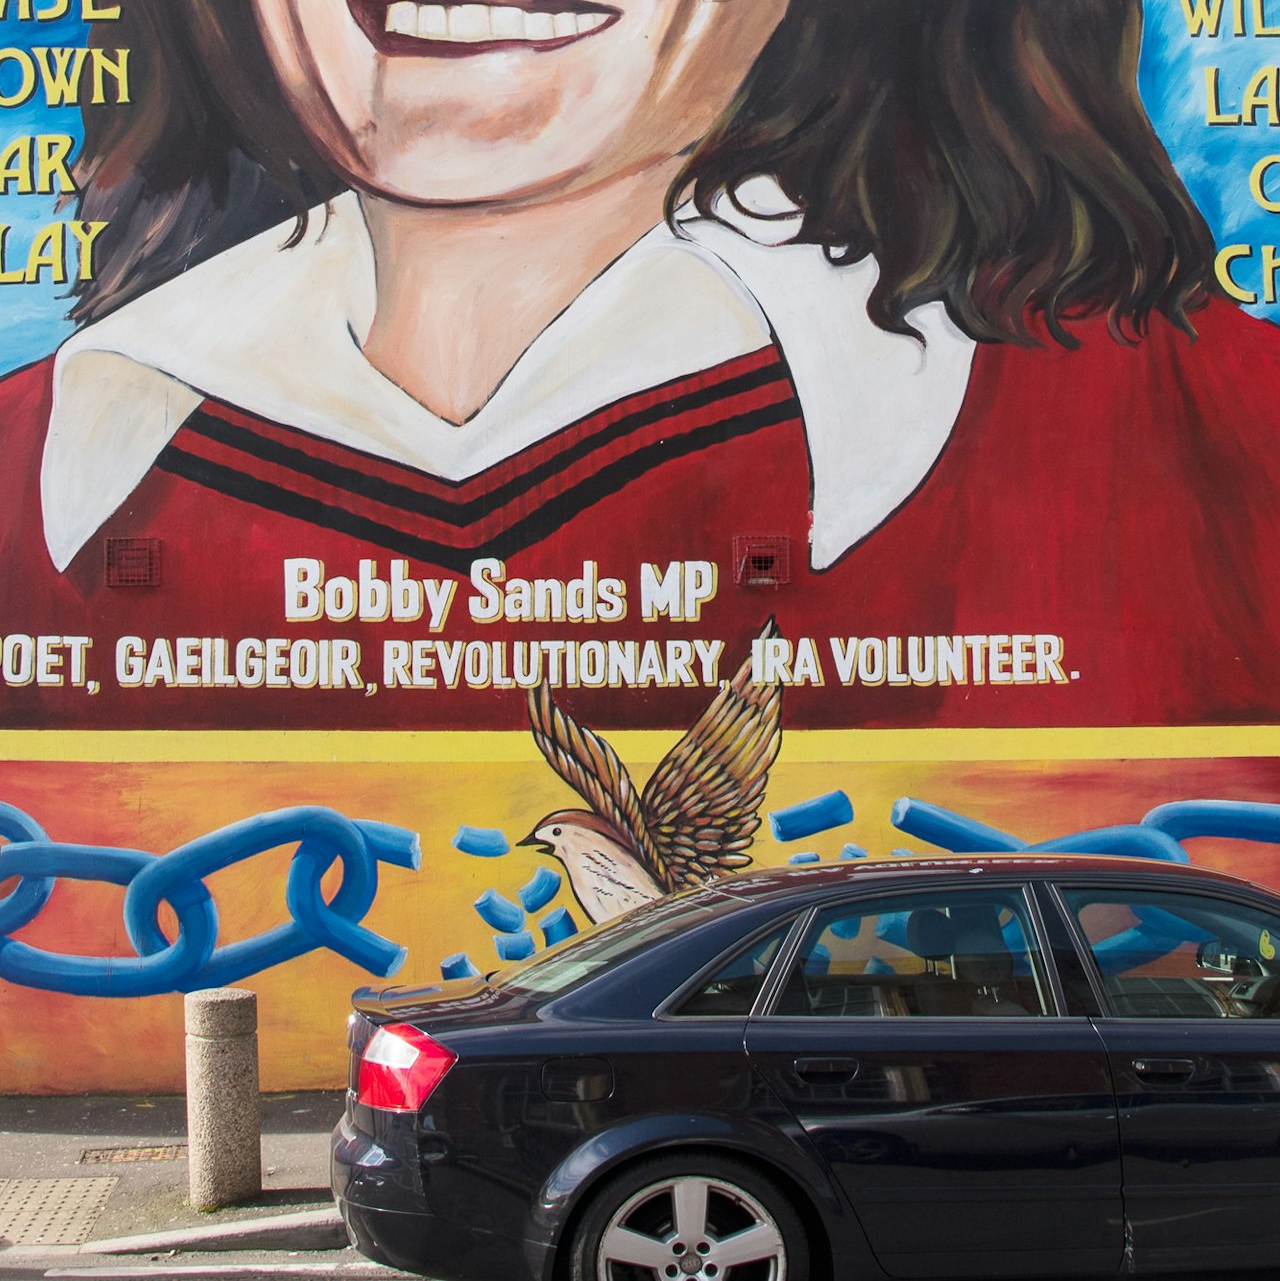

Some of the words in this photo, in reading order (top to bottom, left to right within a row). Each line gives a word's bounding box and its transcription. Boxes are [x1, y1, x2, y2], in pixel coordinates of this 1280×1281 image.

[284, 558, 458, 632] Bobby
[468, 558, 627, 623] Sands
[640, 560, 718, 623] MP
[116, 636, 378, 697] GAEILGEOIR,
[383, 640, 731, 692] REVOLUTIONARY,
[751, 637, 825, 687] IRA
[829, 634, 1080, 687] VOLUNTEER.
